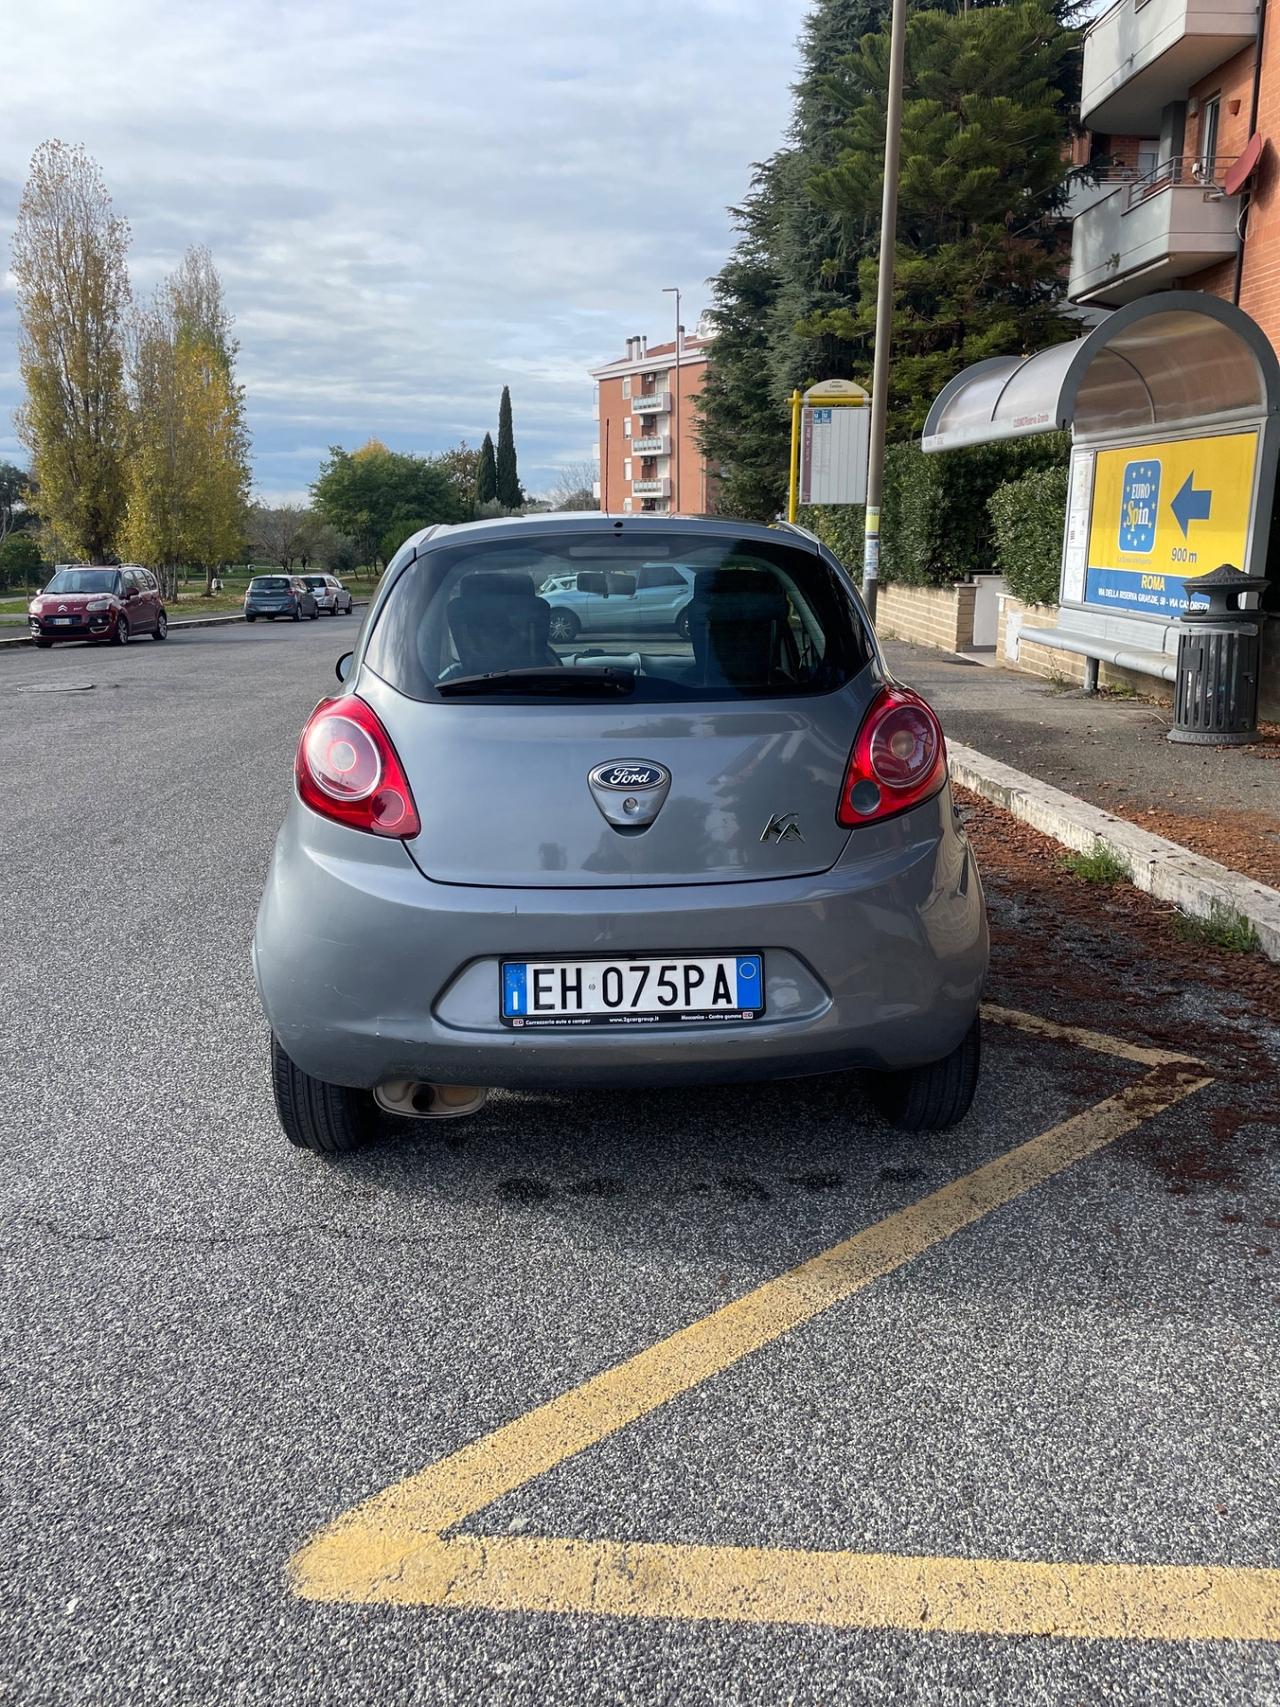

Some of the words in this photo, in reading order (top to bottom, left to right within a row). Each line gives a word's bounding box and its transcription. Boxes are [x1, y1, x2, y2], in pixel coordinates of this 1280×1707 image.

[1131, 483, 1150, 499] EURO
[1126, 500, 1149, 532] Spin
[1171, 547, 1187, 562] 900
[1188, 552, 1197, 564] m
[1141, 574, 1166, 592] ROMA
[1105, 589, 1118, 598] DELLA
[1169, 598, 1178, 609] VIA
[609, 767, 650, 785] Ford
[533, 967, 583, 1010] EH
[602, 963, 733, 1008] 075PA
